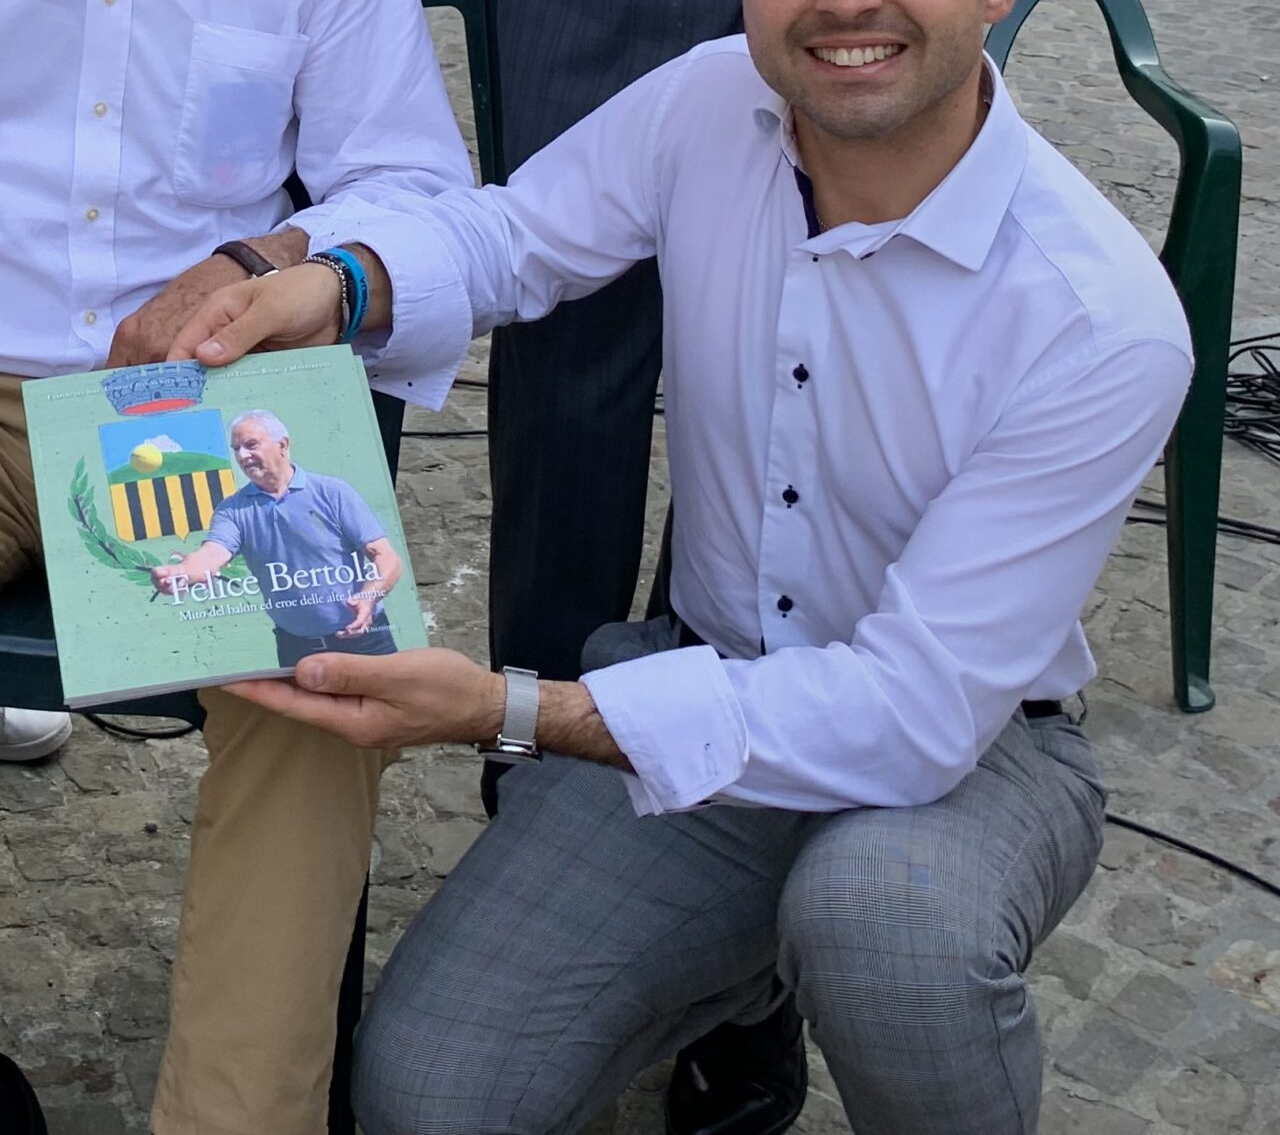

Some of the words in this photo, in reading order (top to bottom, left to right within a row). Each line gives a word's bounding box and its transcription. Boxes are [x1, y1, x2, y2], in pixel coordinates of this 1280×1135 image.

[168, 569, 260, 606] Felice
[265, 551, 384, 592] Bertola
[180, 610, 207, 622] Mito
[209, 606, 225, 617] del
[260, 598, 273, 610] ed
[275, 599, 297, 609] eroe
[299, 593, 324, 606] delle
[326, 591, 345, 603] alte
[347, 586, 387, 602] Langhe
